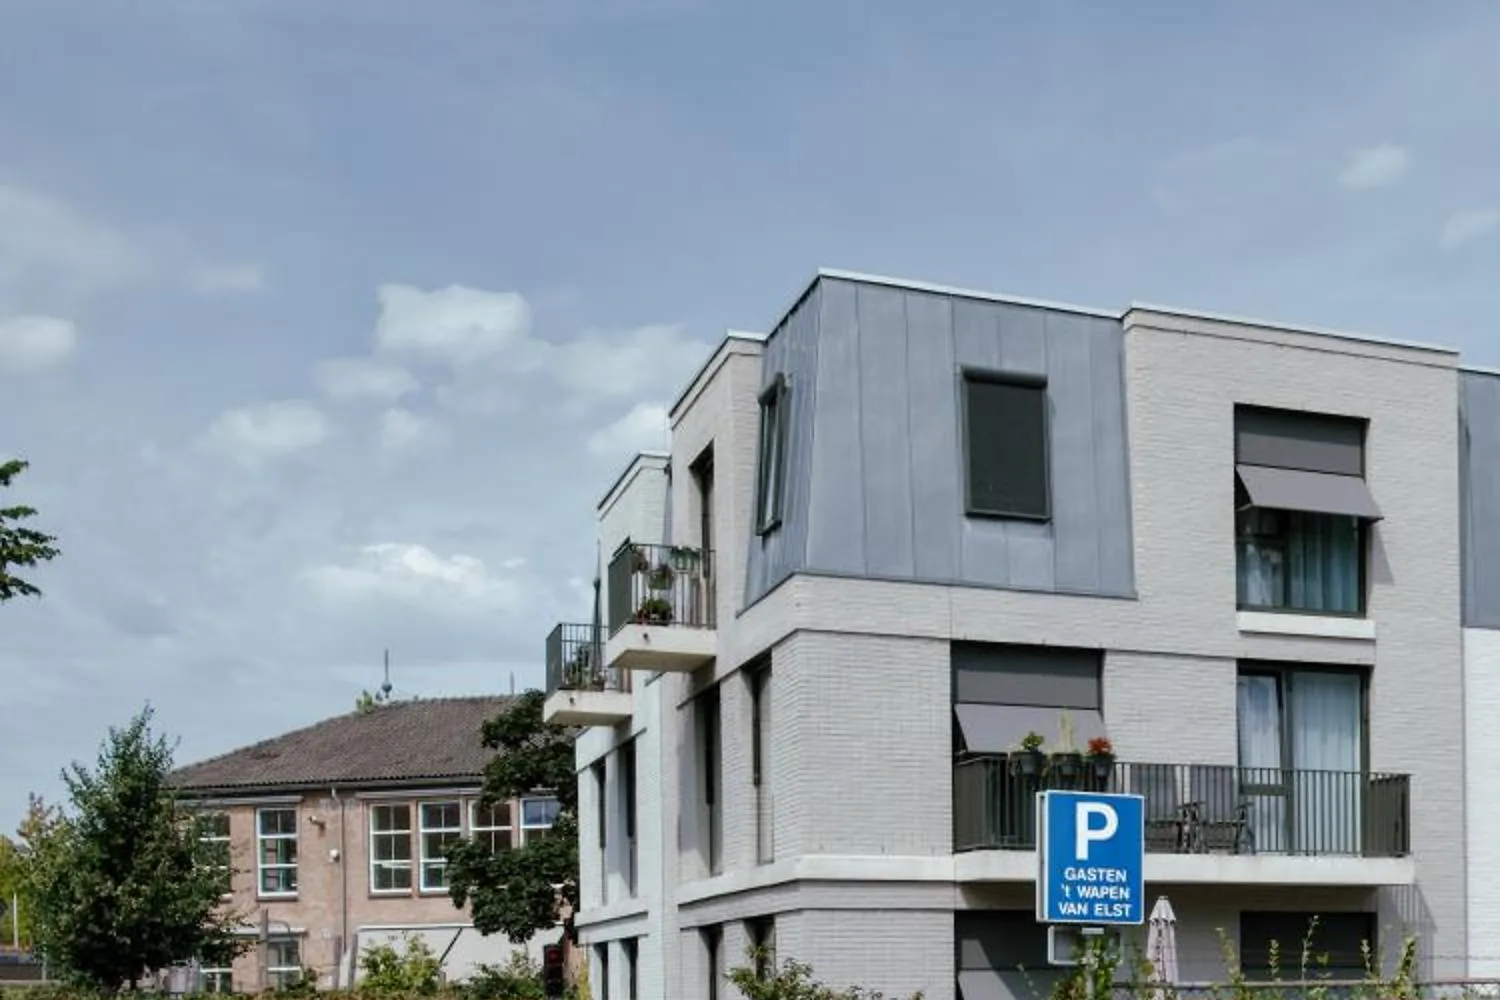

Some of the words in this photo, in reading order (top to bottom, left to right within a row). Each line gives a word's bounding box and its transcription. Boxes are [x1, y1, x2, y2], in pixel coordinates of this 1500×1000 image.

[1075, 801, 1119, 861] P
[1064, 867, 1127, 882] GASTEN
[1077, 886, 1130, 900] WAPEN
[1058, 902, 1088, 915] VAN
[1094, 903, 1132, 917] ELST
